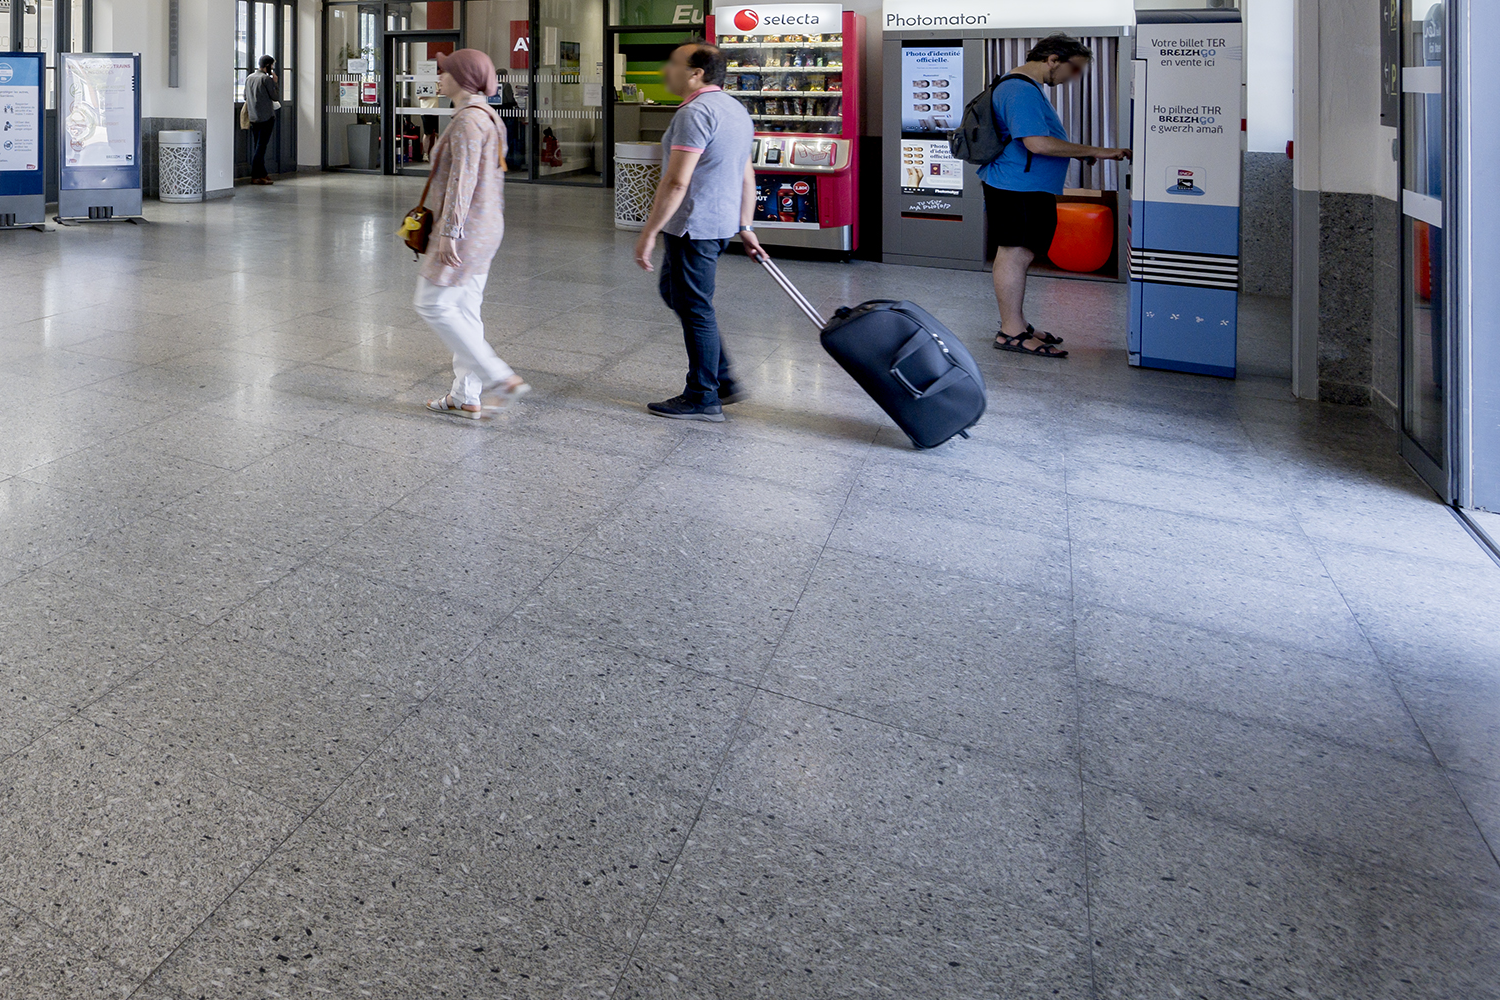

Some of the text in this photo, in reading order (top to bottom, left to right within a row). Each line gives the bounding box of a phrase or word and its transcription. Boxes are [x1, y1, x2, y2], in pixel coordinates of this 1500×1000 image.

[763, 13, 819, 26] selecta
[1151, 37, 1225, 48] Votre billet TER
[1175, 58, 1202, 67] vente
[1204, 58, 1215, 67] ici
[1153, 105, 1222, 116] Ho pilhed THR
[1158, 124, 1194, 135] gwerzh
[1196, 125, 1224, 134] amañ
